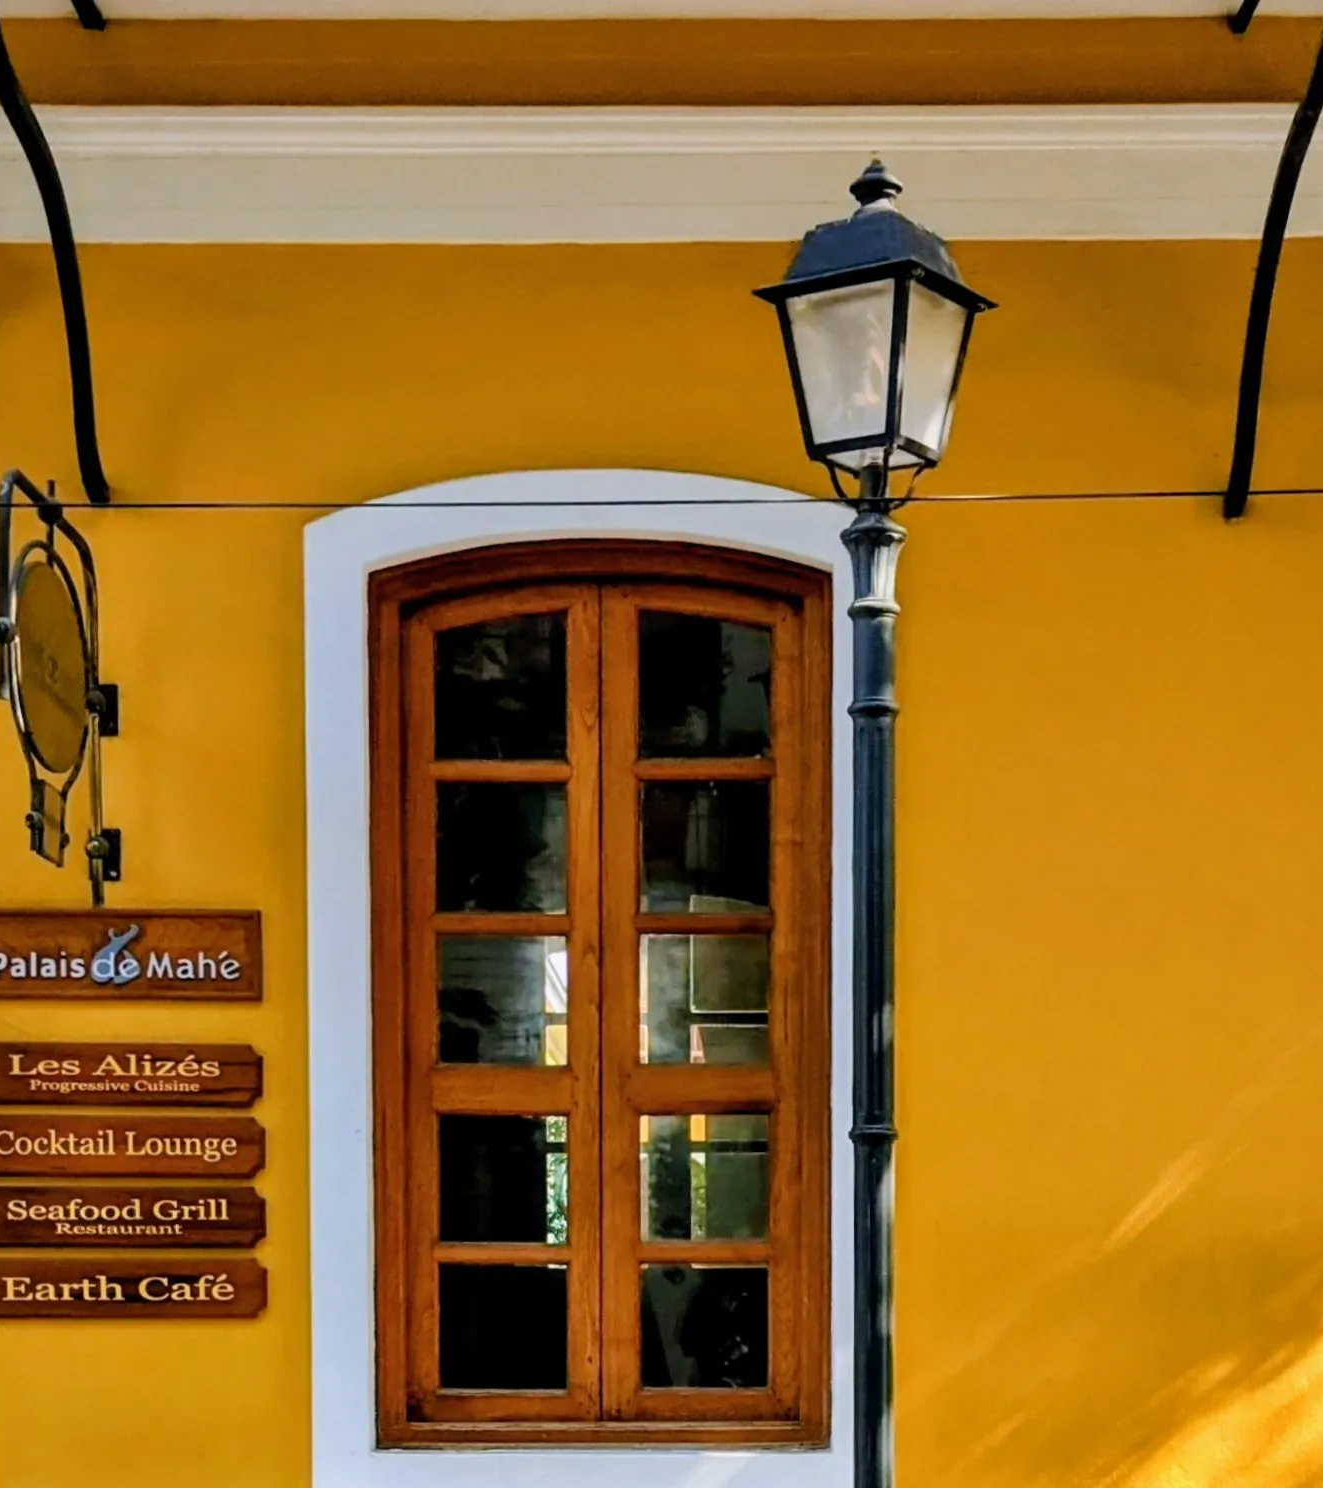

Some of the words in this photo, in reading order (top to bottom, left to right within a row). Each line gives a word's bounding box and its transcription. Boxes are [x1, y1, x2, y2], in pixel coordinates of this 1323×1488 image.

[91, 951, 140, 981] de
[146, 950, 241, 980] Mahé
[8, 1054, 81, 1076] Les
[92, 1053, 221, 1077] Alizés
[29, 1079, 130, 1093] Progressive
[134, 1079, 200, 1093] Cuisine
[125, 1131, 237, 1163] Lounge
[6, 1199, 143, 1221] Seafood
[153, 1199, 229, 1221] Grill
[55, 1222, 184, 1236] Restaurant
[1, 1275, 125, 1302] Earth
[138, 1273, 235, 1302] Café
